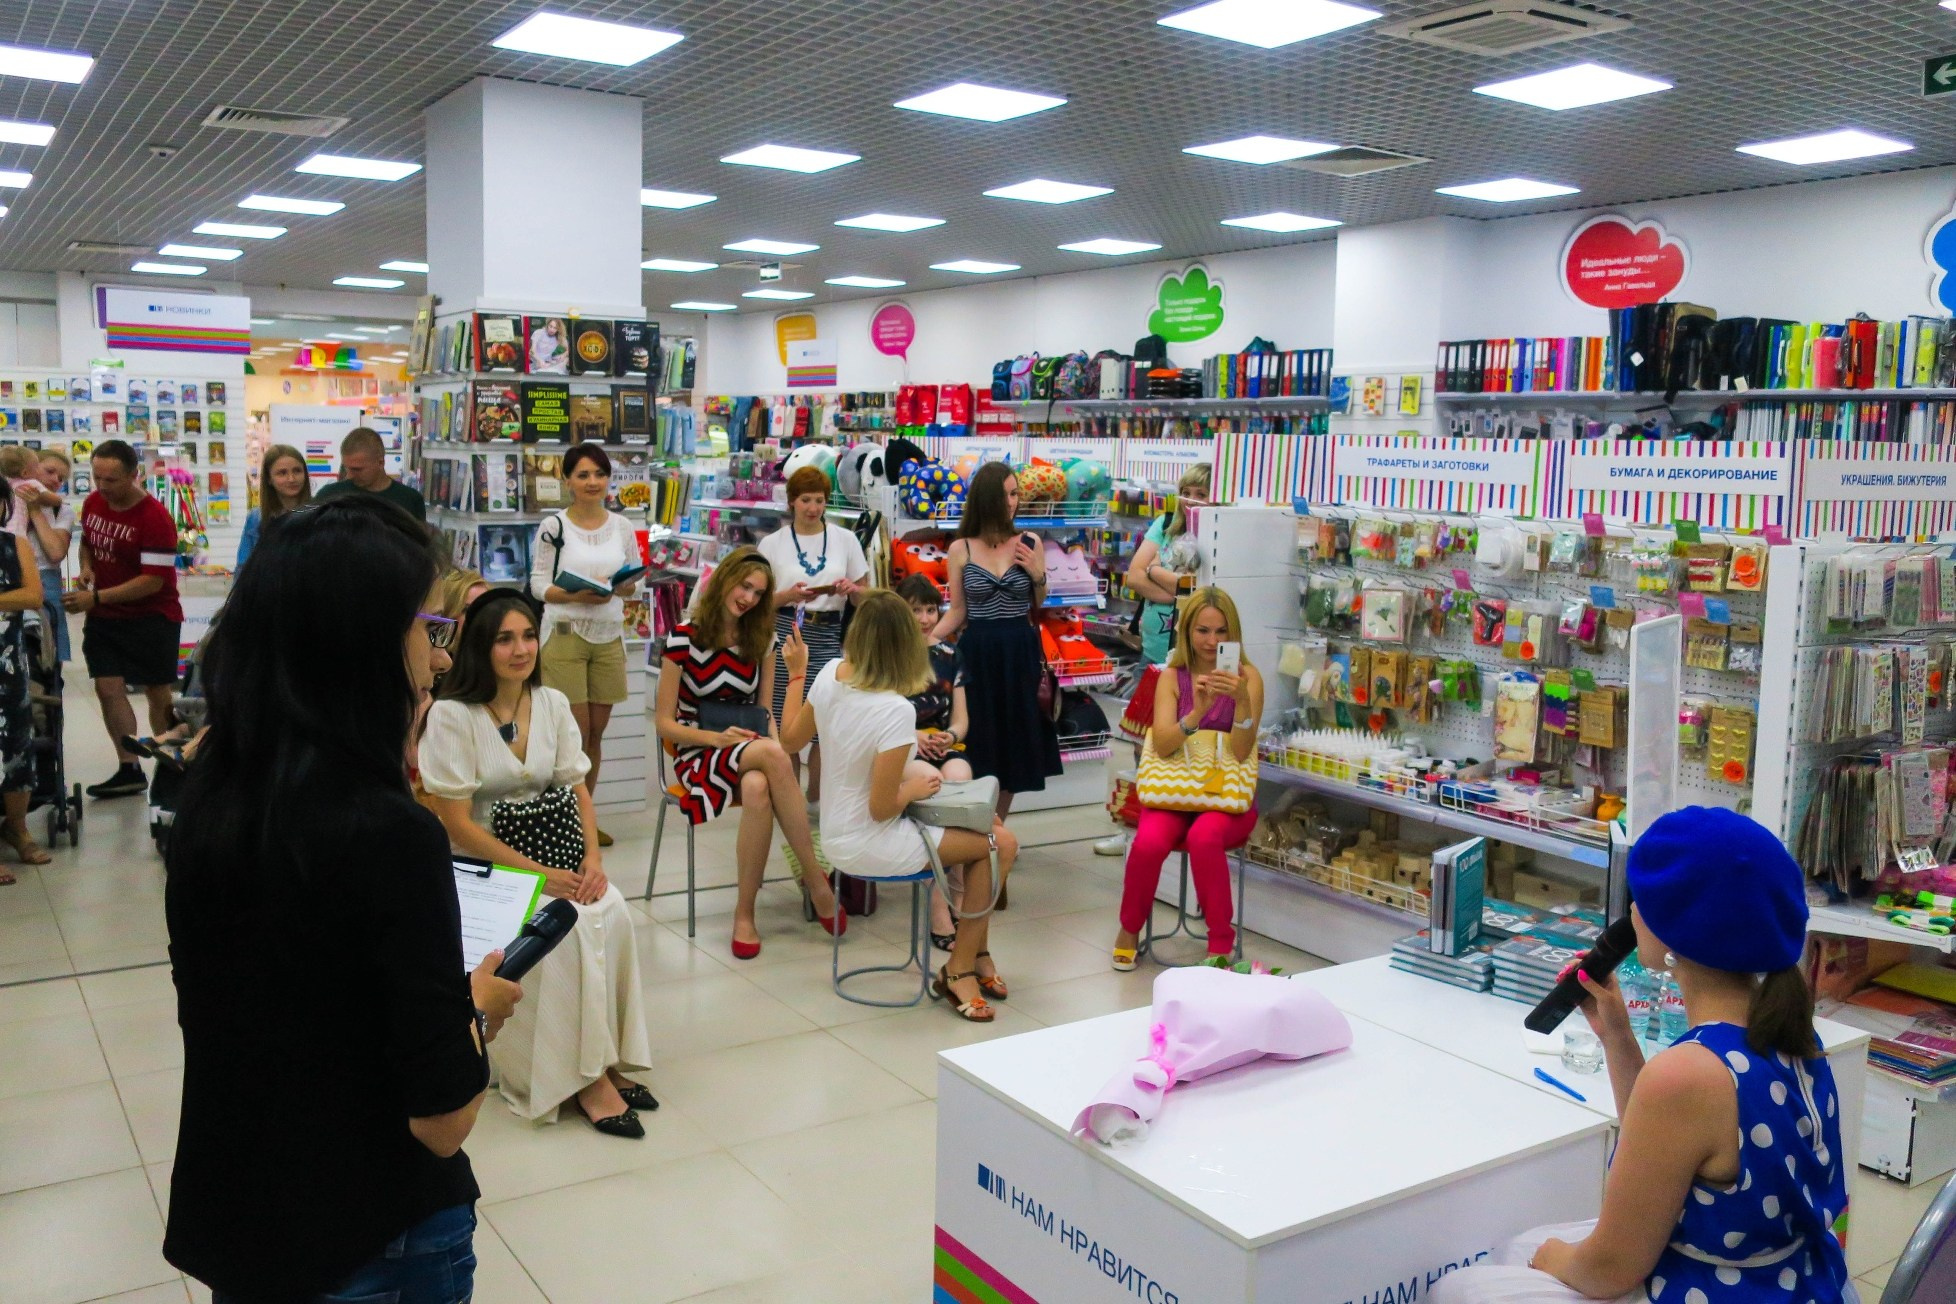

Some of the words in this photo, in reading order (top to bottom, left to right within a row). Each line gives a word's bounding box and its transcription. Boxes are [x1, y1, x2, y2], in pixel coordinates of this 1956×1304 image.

[1581, 257, 1632, 268] Идеальные
[1633, 254, 1659, 264] люди
[1581, 270, 1606, 279] такие
[1367, 457, 1420, 469] ТРАФАРЕТЫ
[1423, 459, 1430, 469] И
[1432, 460, 1490, 472] ЗАГОТОВКИ
[1610, 467, 1654, 478] БУМАГА
[1657, 468, 1665, 478] И
[1668, 468, 1778, 481] ДЕКОРИРОВАНИЕ
[1841, 474, 1896, 486] УКРАШЕНИЯ.
[1897, 475, 1948, 487] БИЖУТЕРИЯ
[1012, 1186, 1054, 1236] НАМ
